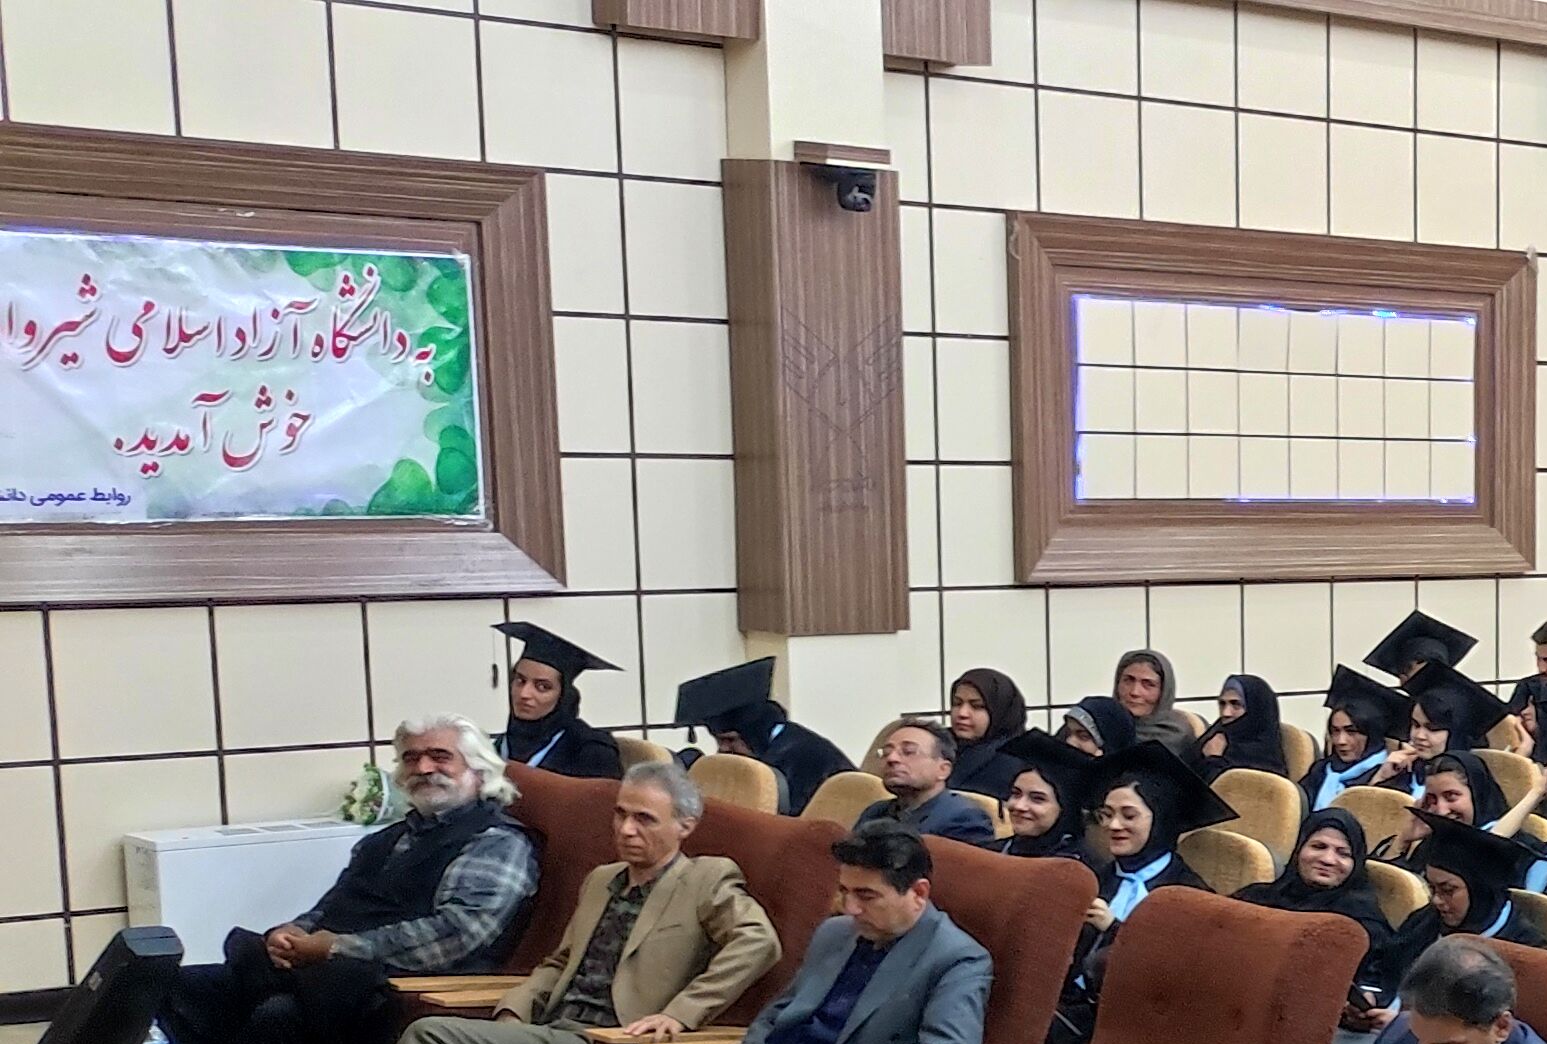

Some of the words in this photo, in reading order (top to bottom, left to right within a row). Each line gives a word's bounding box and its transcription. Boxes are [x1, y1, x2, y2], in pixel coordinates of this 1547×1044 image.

[7, 272, 99, 370] شیروا
[104, 299, 222, 365] اسلامی
[229, 298, 318, 361] آزاد
[309, 265, 409, 362] دانشگاه
[412, 346, 437, 384] به
[221, 386, 313, 470] خوش
[30, 491, 87, 507] عمومی
[90, 487, 131, 507] روابط
